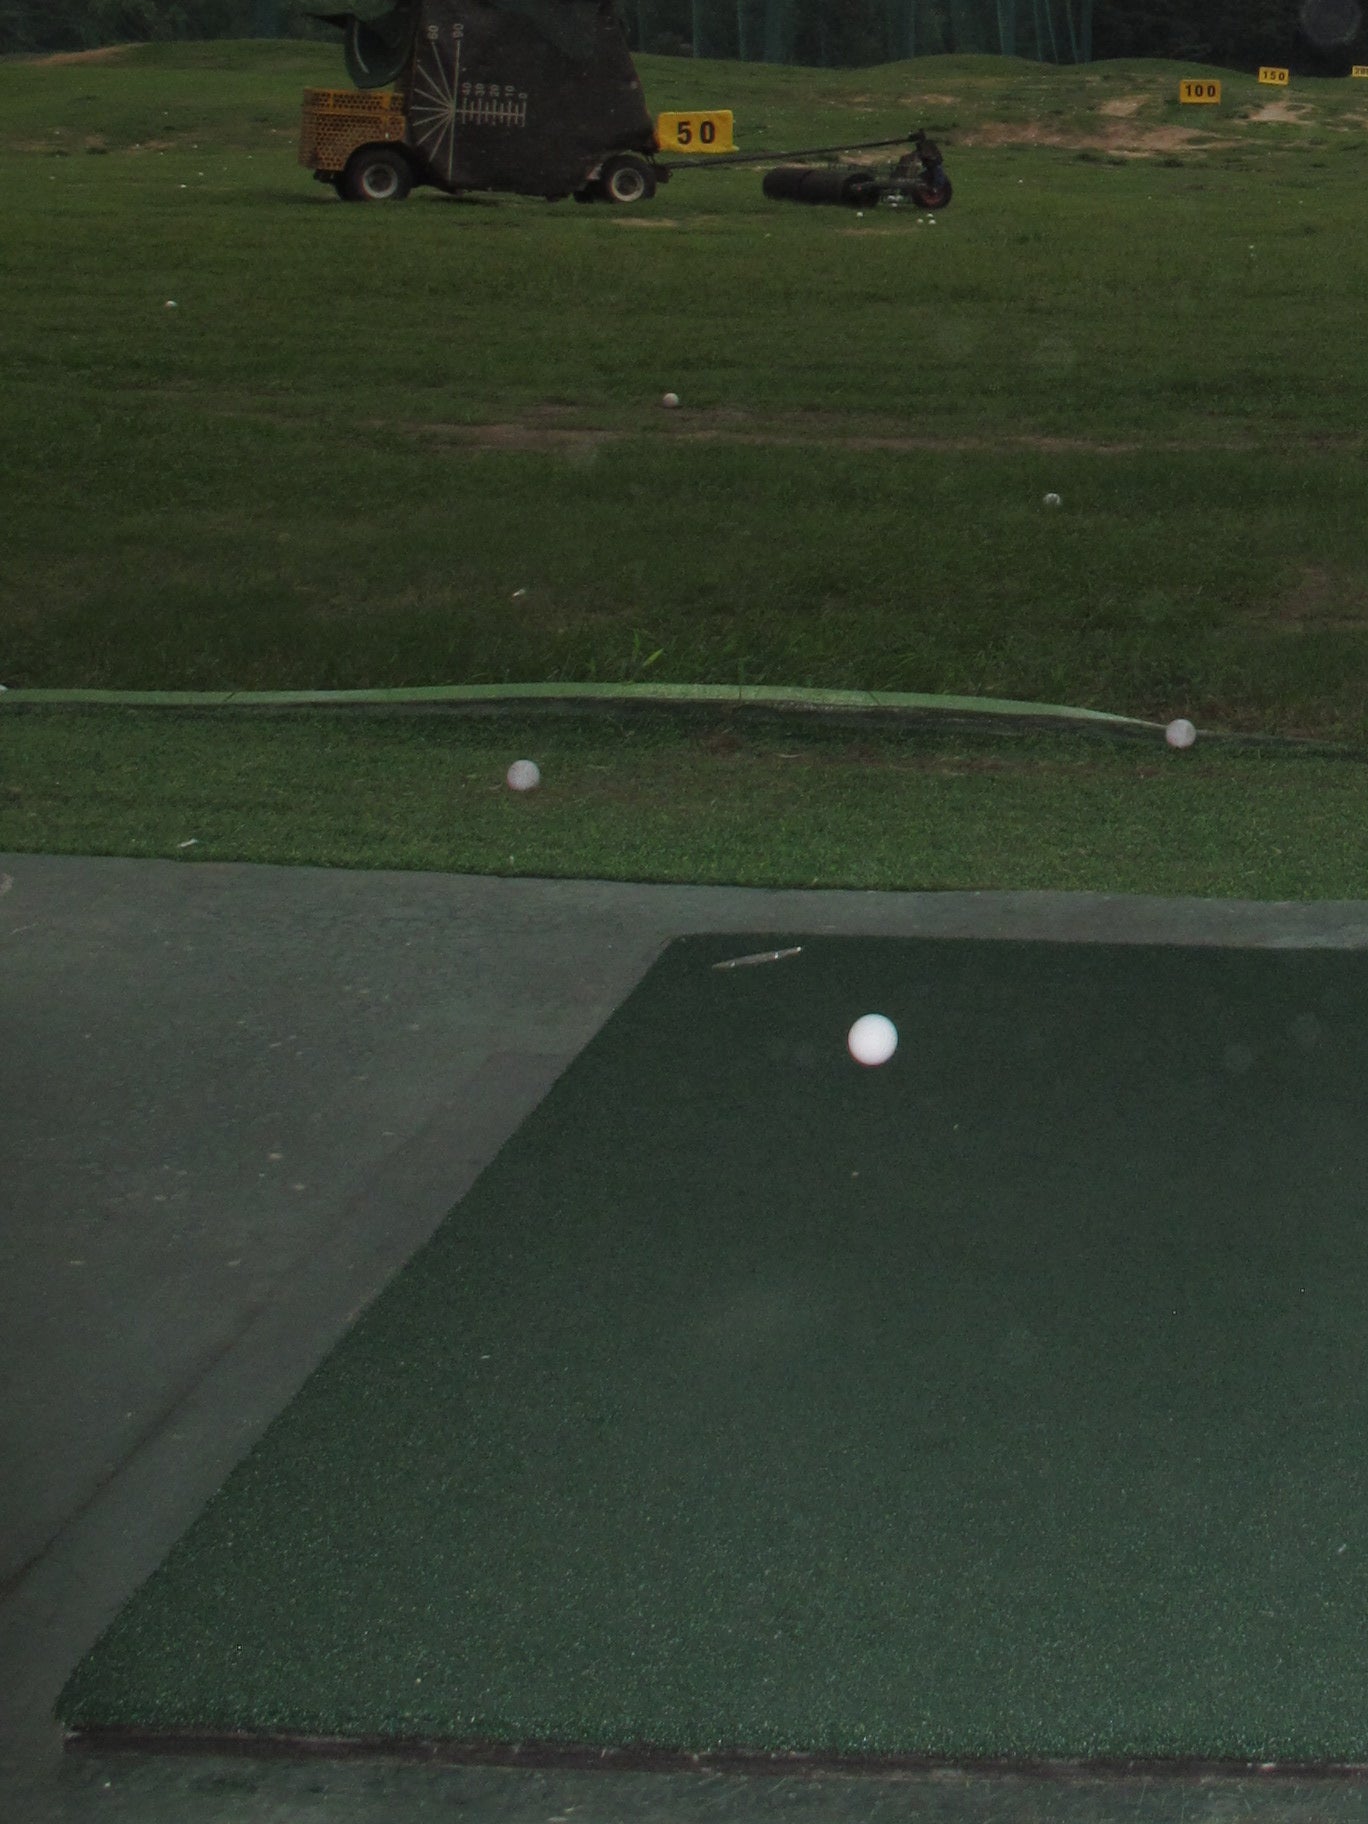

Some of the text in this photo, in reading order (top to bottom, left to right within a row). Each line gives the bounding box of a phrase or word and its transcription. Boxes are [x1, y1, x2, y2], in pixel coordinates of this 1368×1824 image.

[1262, 69, 1286, 82] 150
[1184, 84, 1217, 98] 100
[677, 120, 716, 145] 50
